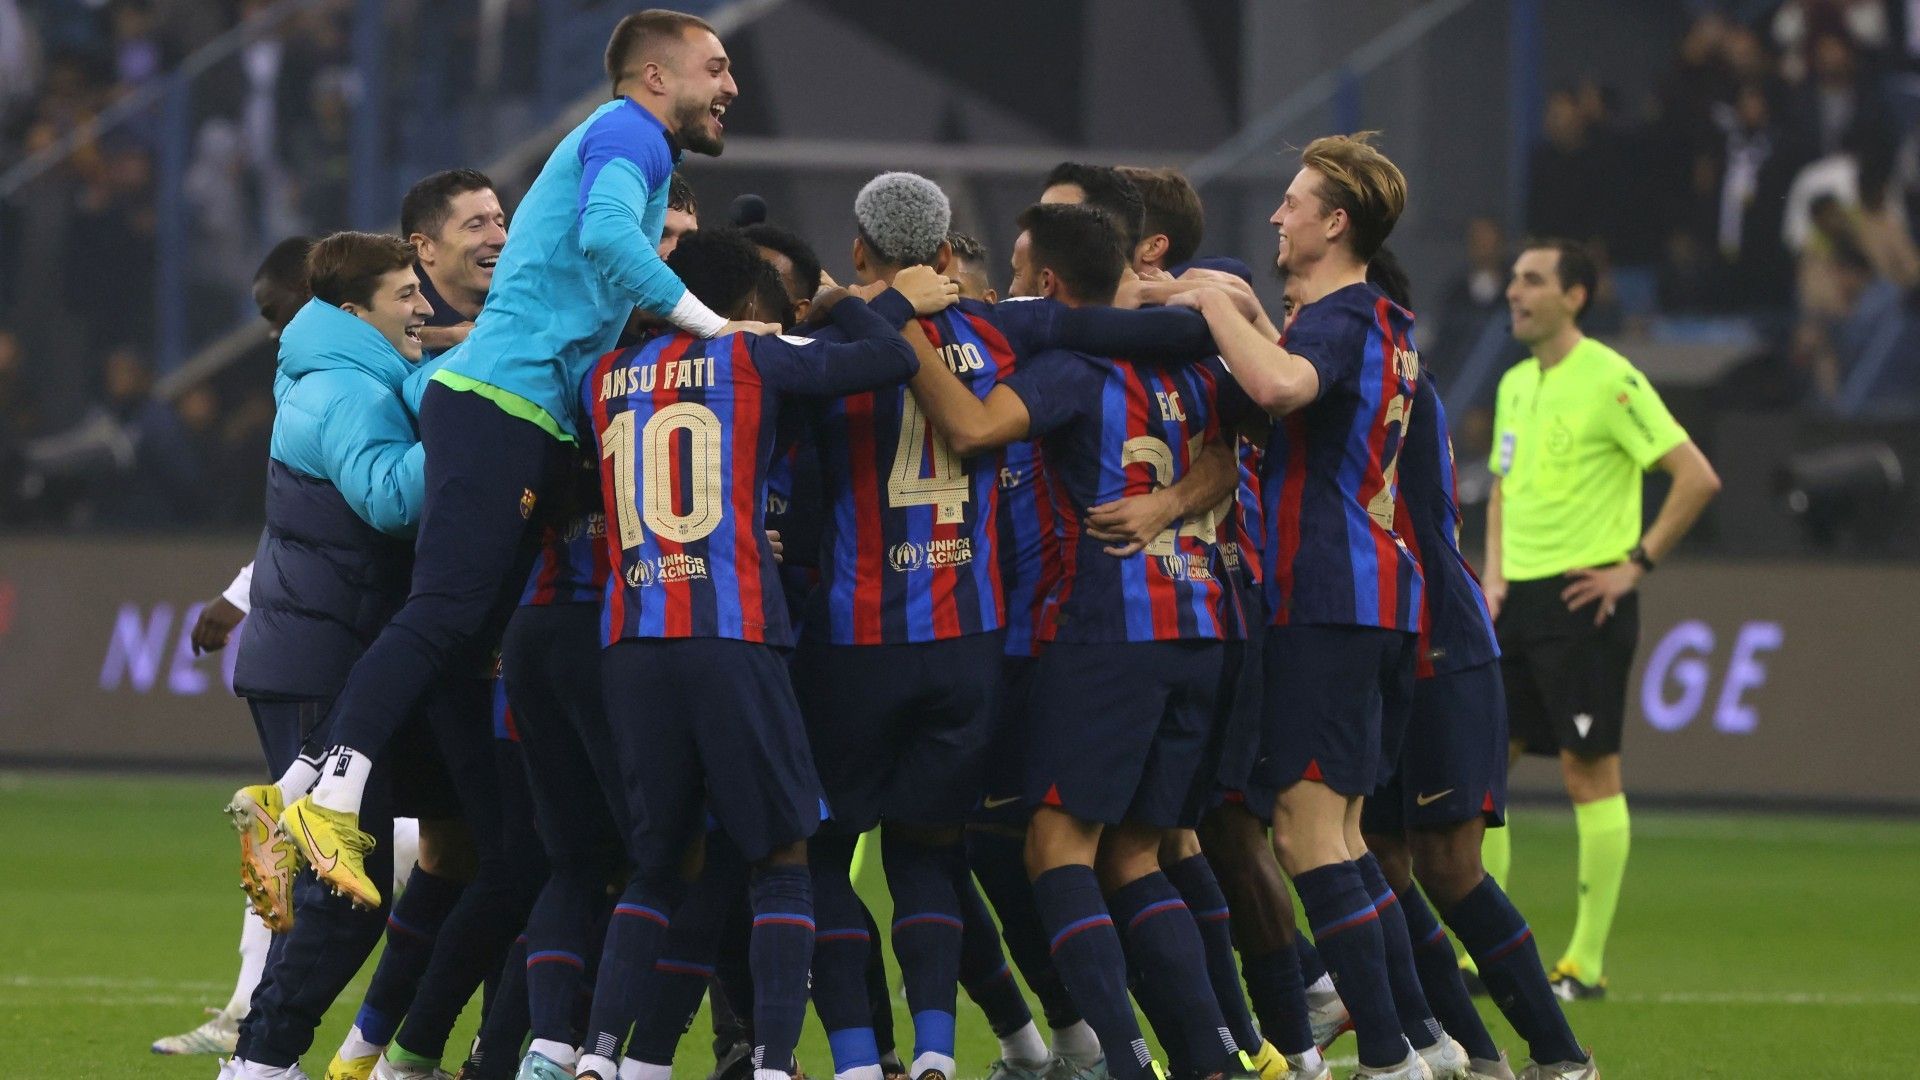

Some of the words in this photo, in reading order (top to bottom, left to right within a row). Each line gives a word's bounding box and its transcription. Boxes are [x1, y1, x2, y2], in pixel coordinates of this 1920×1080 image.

[599, 364, 657, 402] ANSU
[663, 357, 715, 389] FATI
[888, 387, 969, 524] 4
[601, 401, 723, 551] 10
[926, 537, 970, 553] UNHCR
[657, 553, 705, 568] UNHCR
[927, 549, 973, 564] ACNUR
[657, 563, 707, 578] ACNUR
